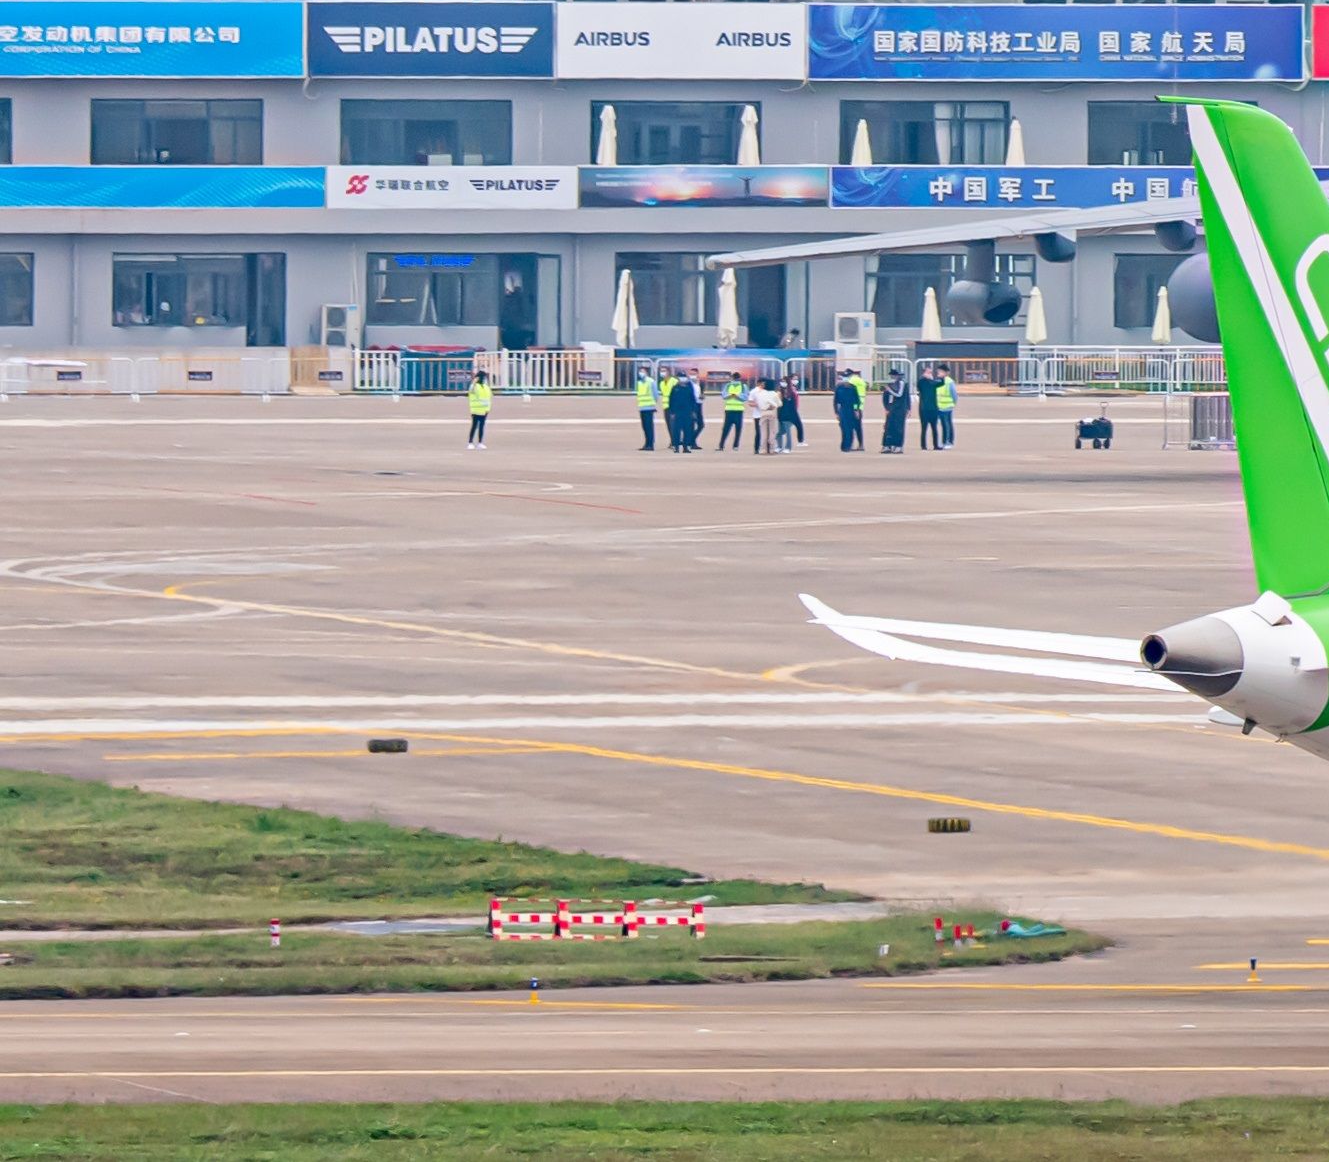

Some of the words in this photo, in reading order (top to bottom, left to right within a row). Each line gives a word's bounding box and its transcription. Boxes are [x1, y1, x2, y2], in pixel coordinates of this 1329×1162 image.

[364, 27, 498, 53] PILATUS
[574, 31, 650, 47] AIRBUS
[716, 32, 791, 48] AIRBUS
[873, 30, 1081, 54] 国家国防科技工业局
[1099, 31, 1246, 54] 国家航天局
[486, 180, 544, 191] PILATUS
[929, 177, 1056, 202] 中国军工
